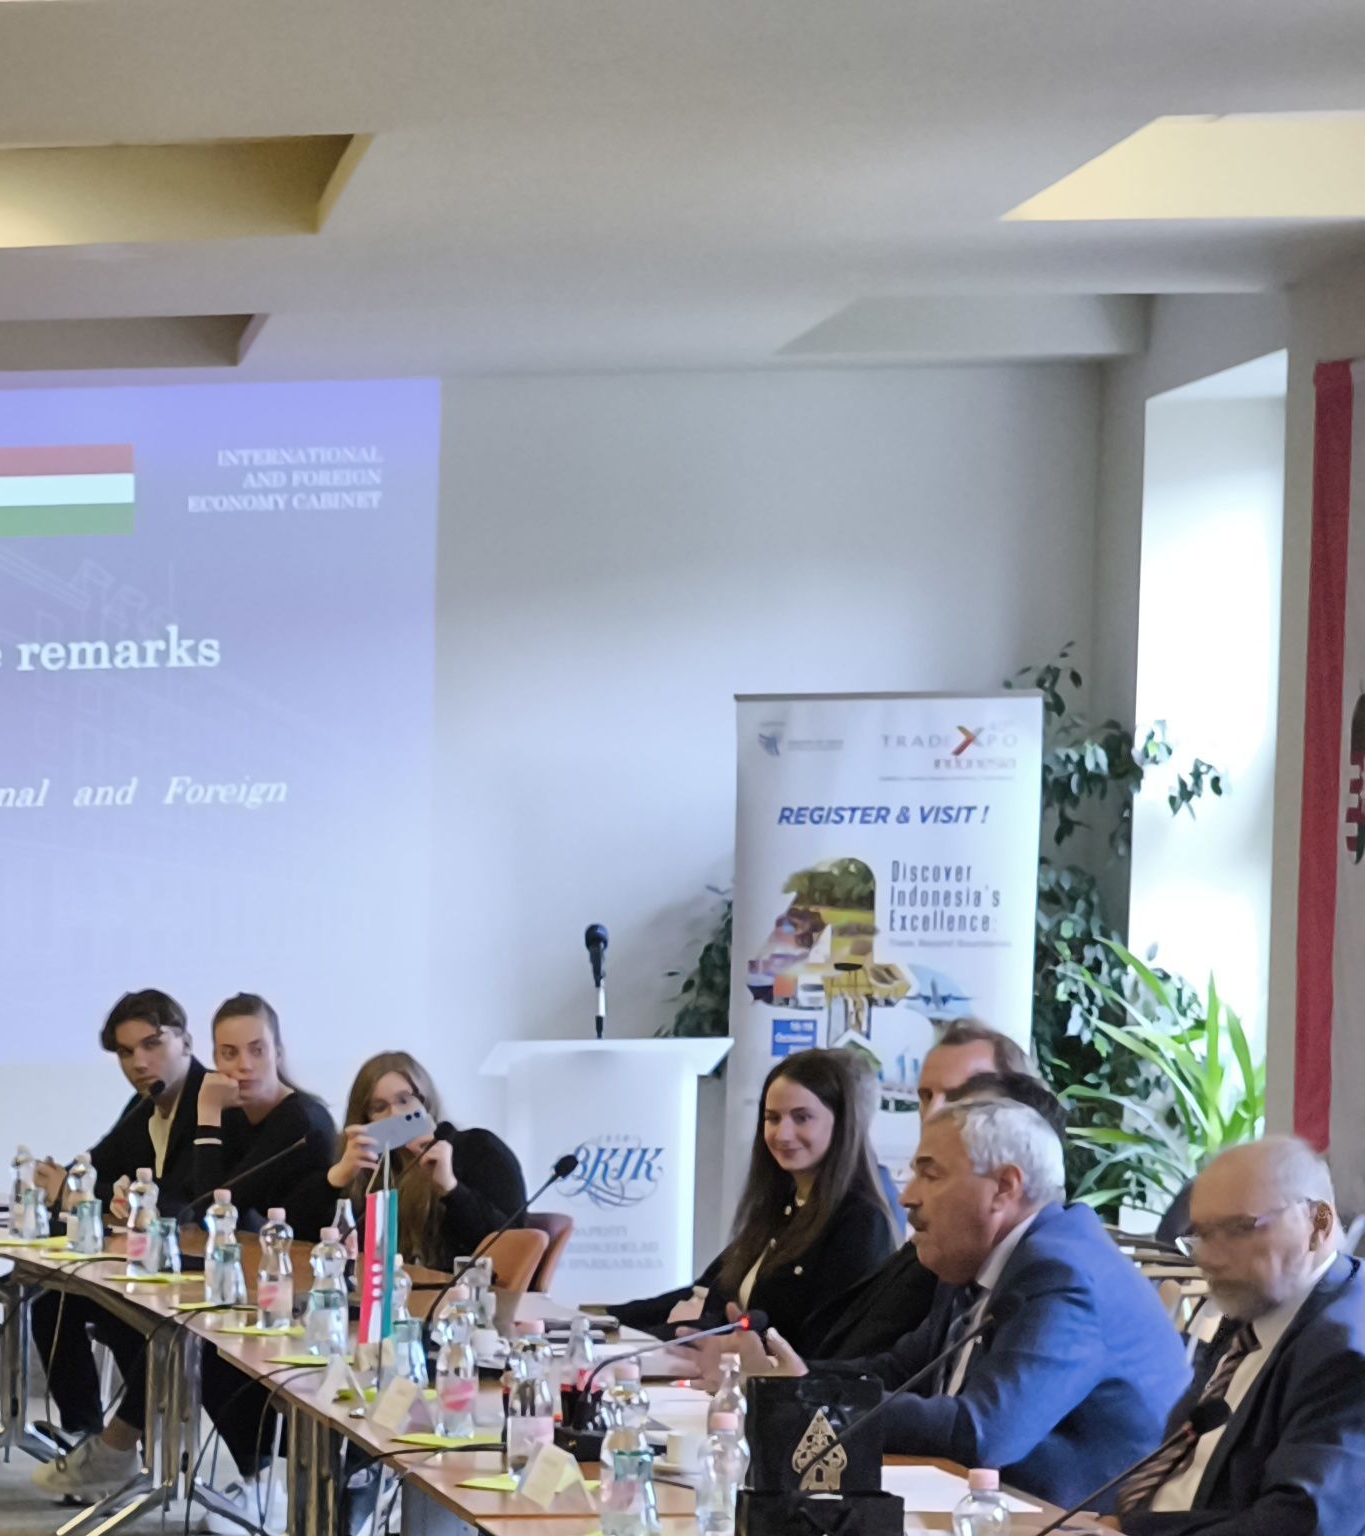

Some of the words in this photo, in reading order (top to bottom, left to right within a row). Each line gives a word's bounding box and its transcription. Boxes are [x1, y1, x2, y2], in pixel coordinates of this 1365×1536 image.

[217, 446, 383, 467] INTERNATIONAL
[243, 471, 287, 488] AND
[292, 469, 382, 486] FOREIGN
[187, 494, 288, 513] ECONOMY
[291, 491, 382, 510] CABINET
[16, 625, 221, 671] remarks
[72, 777, 139, 806] and
[163, 776, 288, 811] Foreign
[778, 806, 891, 825] REGISTER
[897, 807, 910, 824] &
[920, 806, 978, 824] VISIT
[982, 805, 990, 824] !
[891, 860, 972, 882] Discover
[889, 884, 1001, 907] Indonesia's
